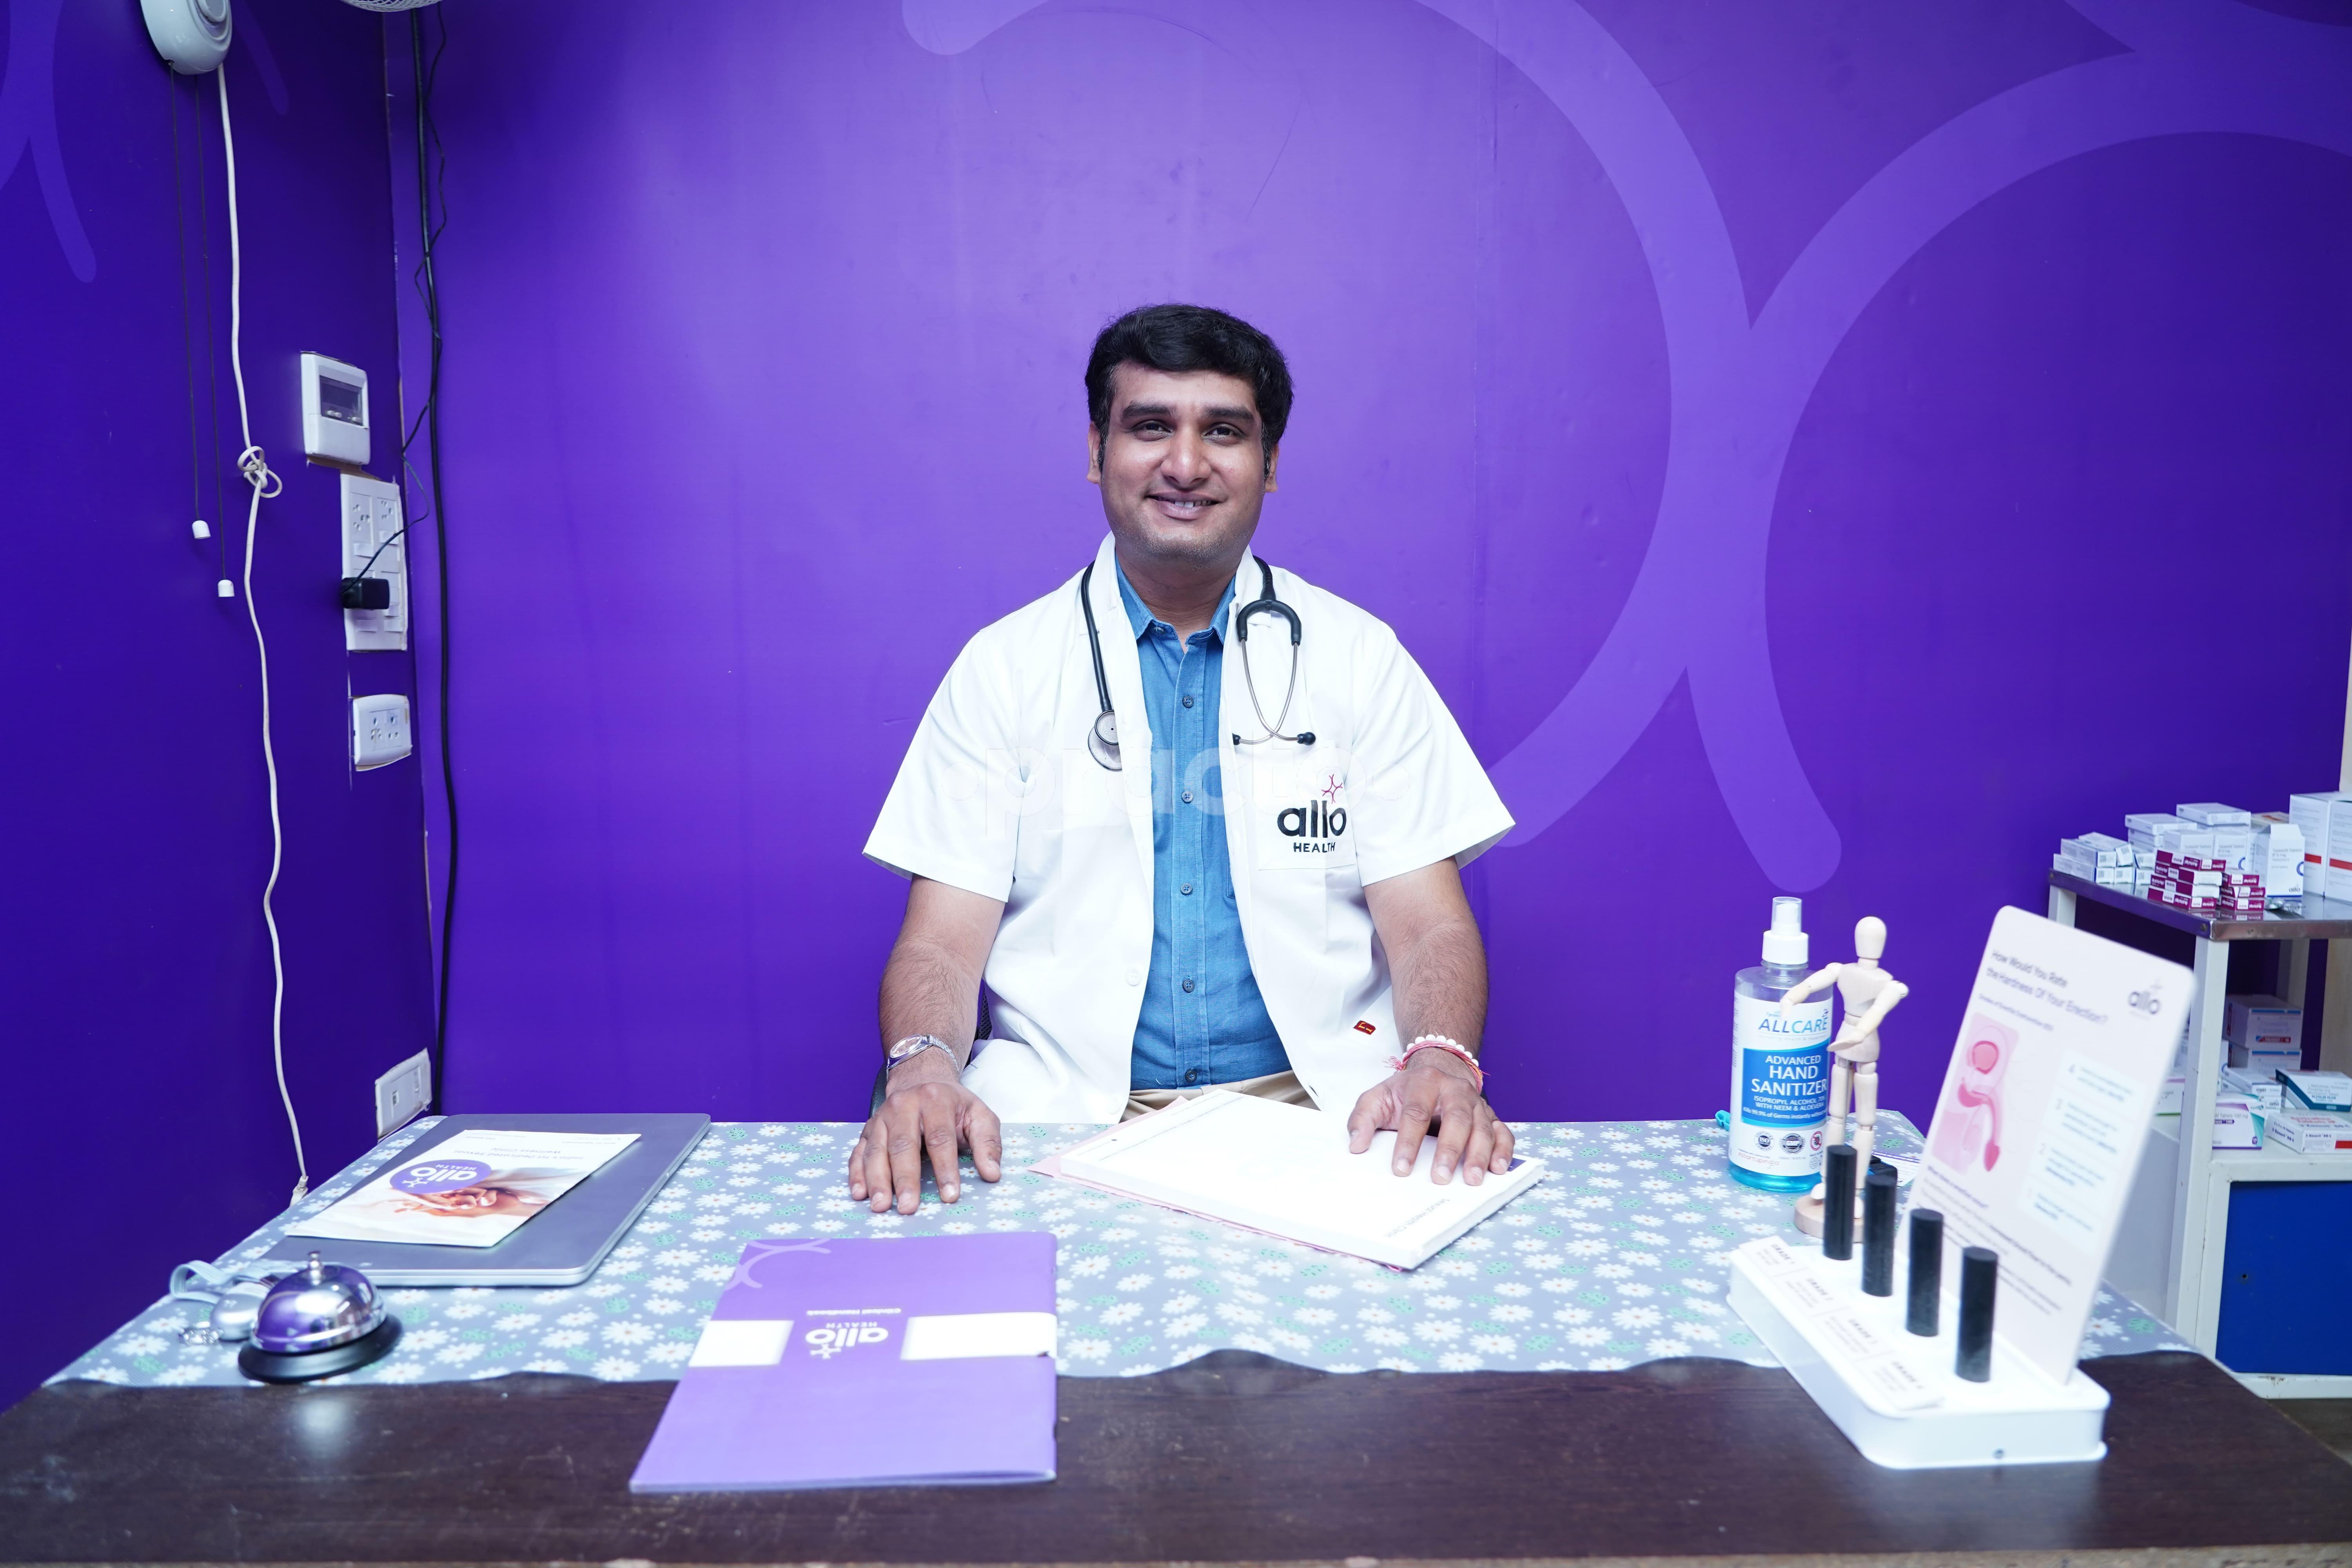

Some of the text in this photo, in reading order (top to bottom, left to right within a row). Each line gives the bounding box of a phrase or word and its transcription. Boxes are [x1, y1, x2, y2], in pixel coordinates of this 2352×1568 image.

[1277, 800, 1347, 838] allo
[1294, 842, 1336, 853] HEALTH
[1992, 950, 2068, 988] How Would You Rate
[1986, 967, 2108, 1025] the Hardness Of Your Erection?
[2127, 990, 2161, 1015] allo
[1758, 1017, 1828, 1033] ALLCARE
[1765, 1055, 1821, 1065] ADVANCED
[1769, 1065, 1818, 1080] HAND
[1751, 1078, 1827, 1096] SANITIZER
[1754, 1095, 1788, 1105] ISOPROPYL
[1755, 1102, 1772, 1110] WITH
[1799, 1102, 1825, 1111] ALOEVERA
[1751, 1109, 1766, 1117] 99.9%
[411, 1167, 477, 1181] allo
[1425, 1198, 1450, 1212] Sexual
[1771, 1243, 1791, 1260] GRADE
[1806, 1278, 1828, 1296] GRADE
[805, 1327, 889, 1347] allo
[1848, 1319, 1871, 1338] GRADE
[1891, 1361, 1917, 1383] GRADE
